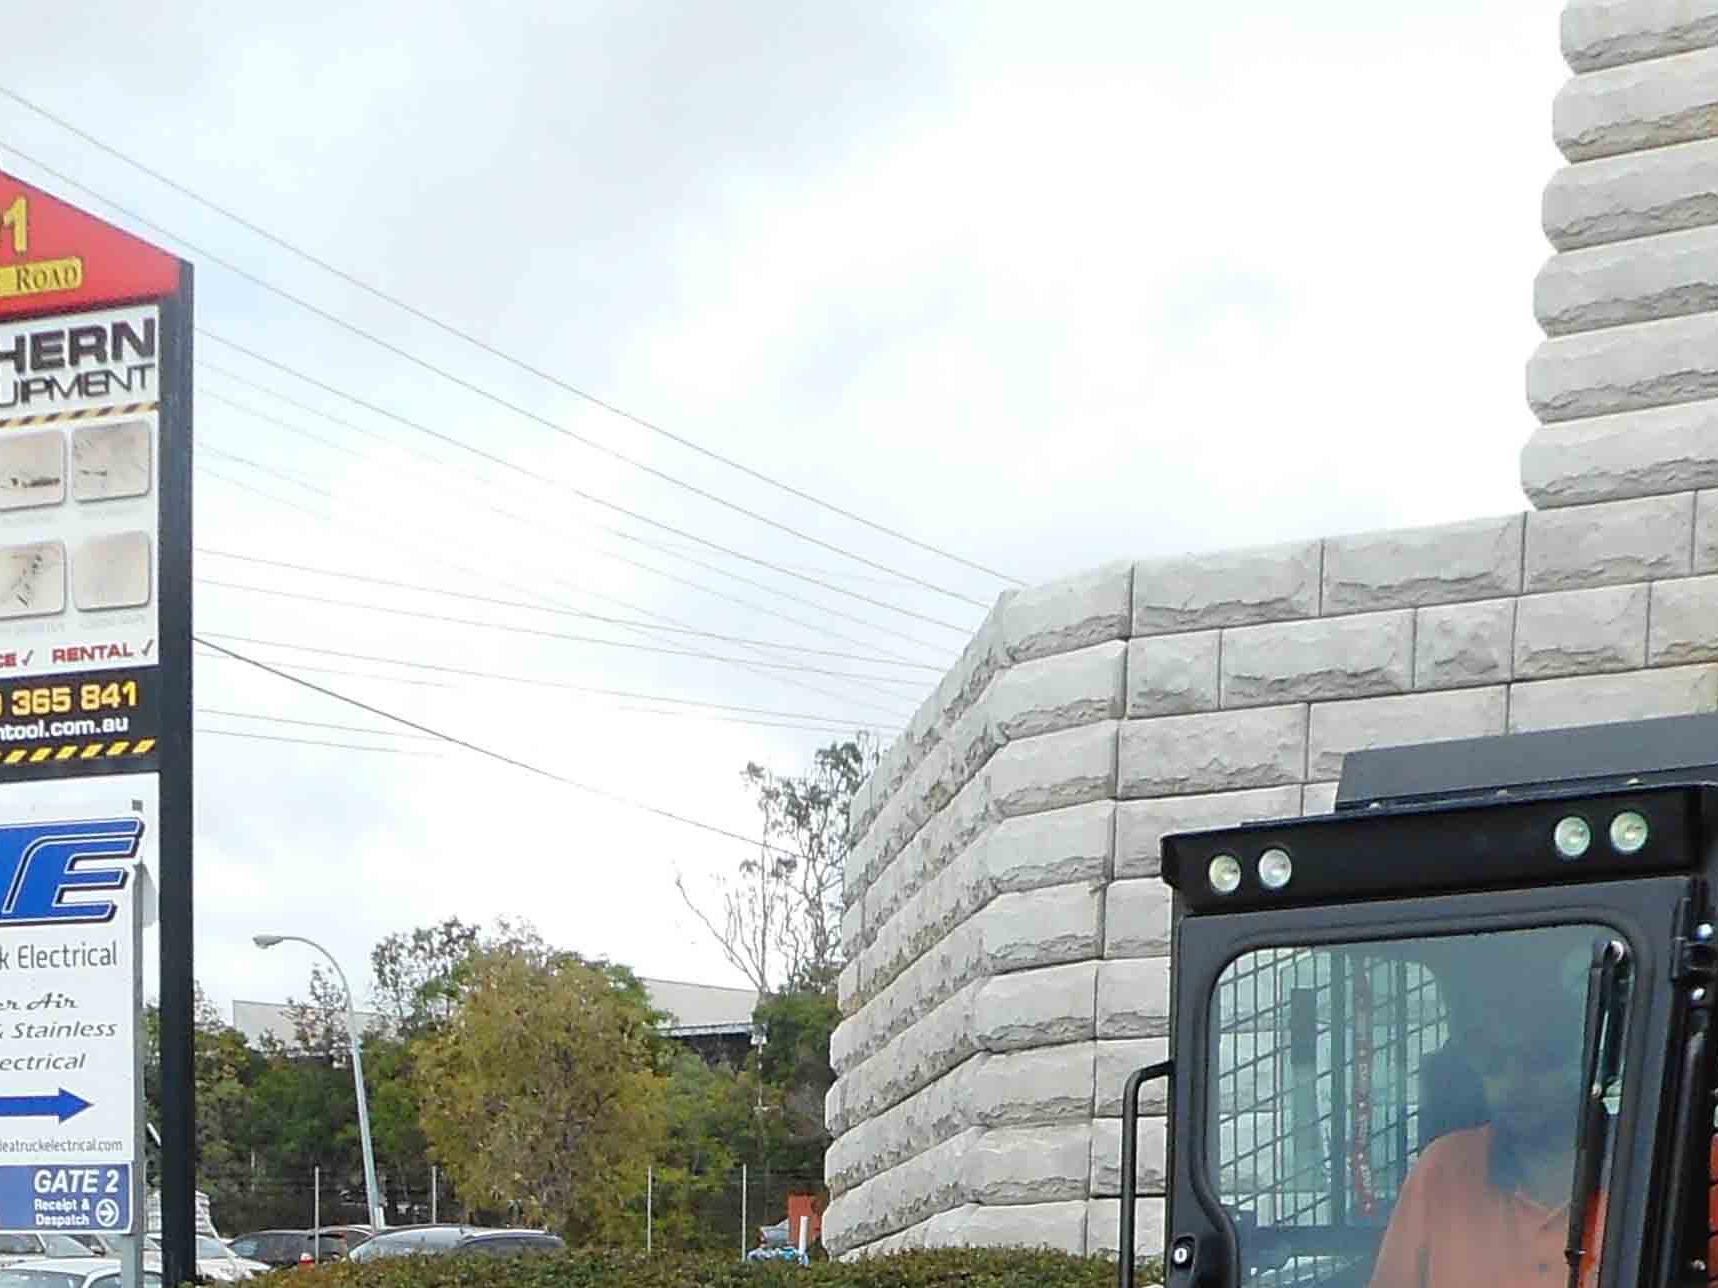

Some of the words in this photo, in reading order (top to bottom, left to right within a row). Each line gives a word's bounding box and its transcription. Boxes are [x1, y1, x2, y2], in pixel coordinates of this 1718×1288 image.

[14, 263, 79, 292] ROAD
[51, 642, 134, 664] RENTAL
[11, 686, 72, 717] 365
[80, 680, 139, 711] 841
[18, 940, 118, 970] Electrical
[26, 991, 79, 1010] Air
[11, 1020, 118, 1039] Stainless
[34, 1169, 99, 1193] GATE
[105, 1169, 119, 1192] 2
[34, 1198, 78, 1213] Receipt
[35, 1213, 90, 1227] Despatch
